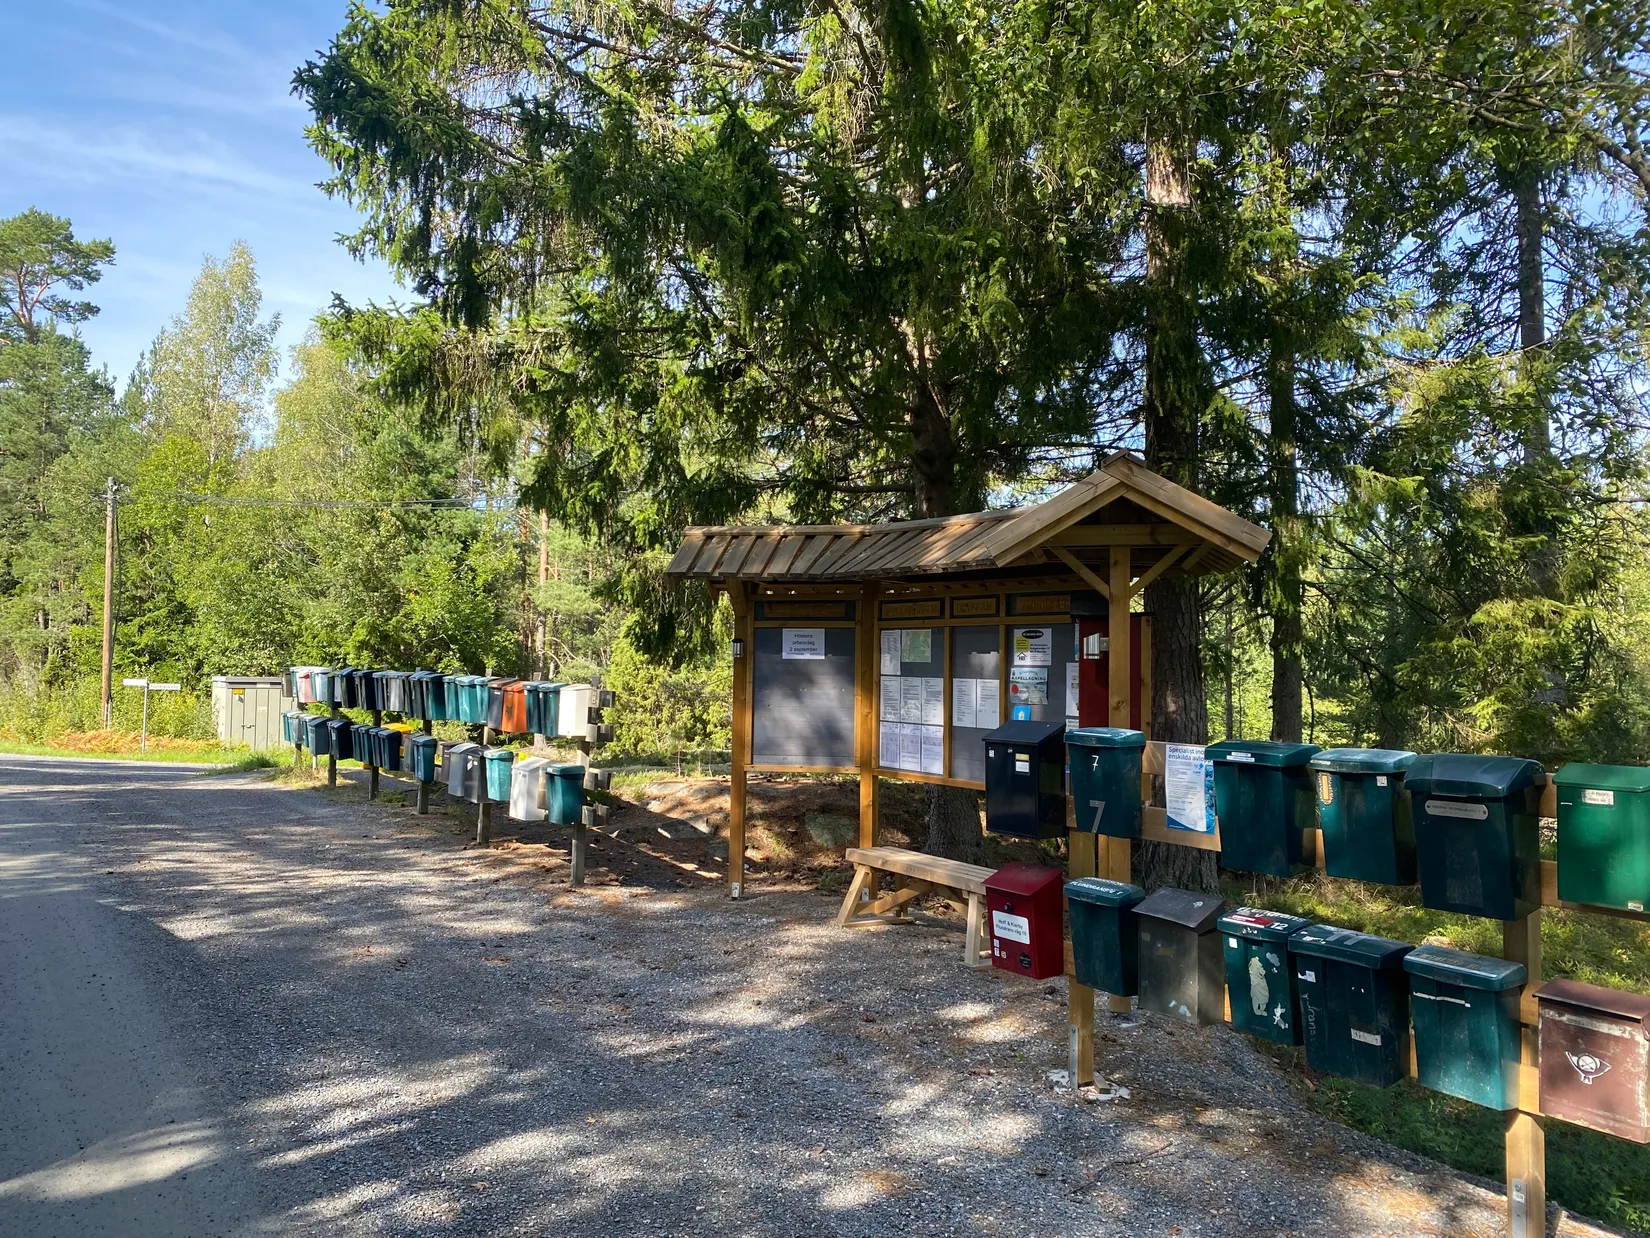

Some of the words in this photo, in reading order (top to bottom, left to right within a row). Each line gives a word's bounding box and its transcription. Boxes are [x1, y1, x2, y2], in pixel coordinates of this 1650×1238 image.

[1168, 746, 1195, 755] Specialist
[1195, 748, 1205, 756] ino
[1168, 753, 1192, 761] enskilda
[1091, 754, 1100, 772] 7
[1089, 799, 1106, 834] 7
[1270, 922, 1289, 931] 12
